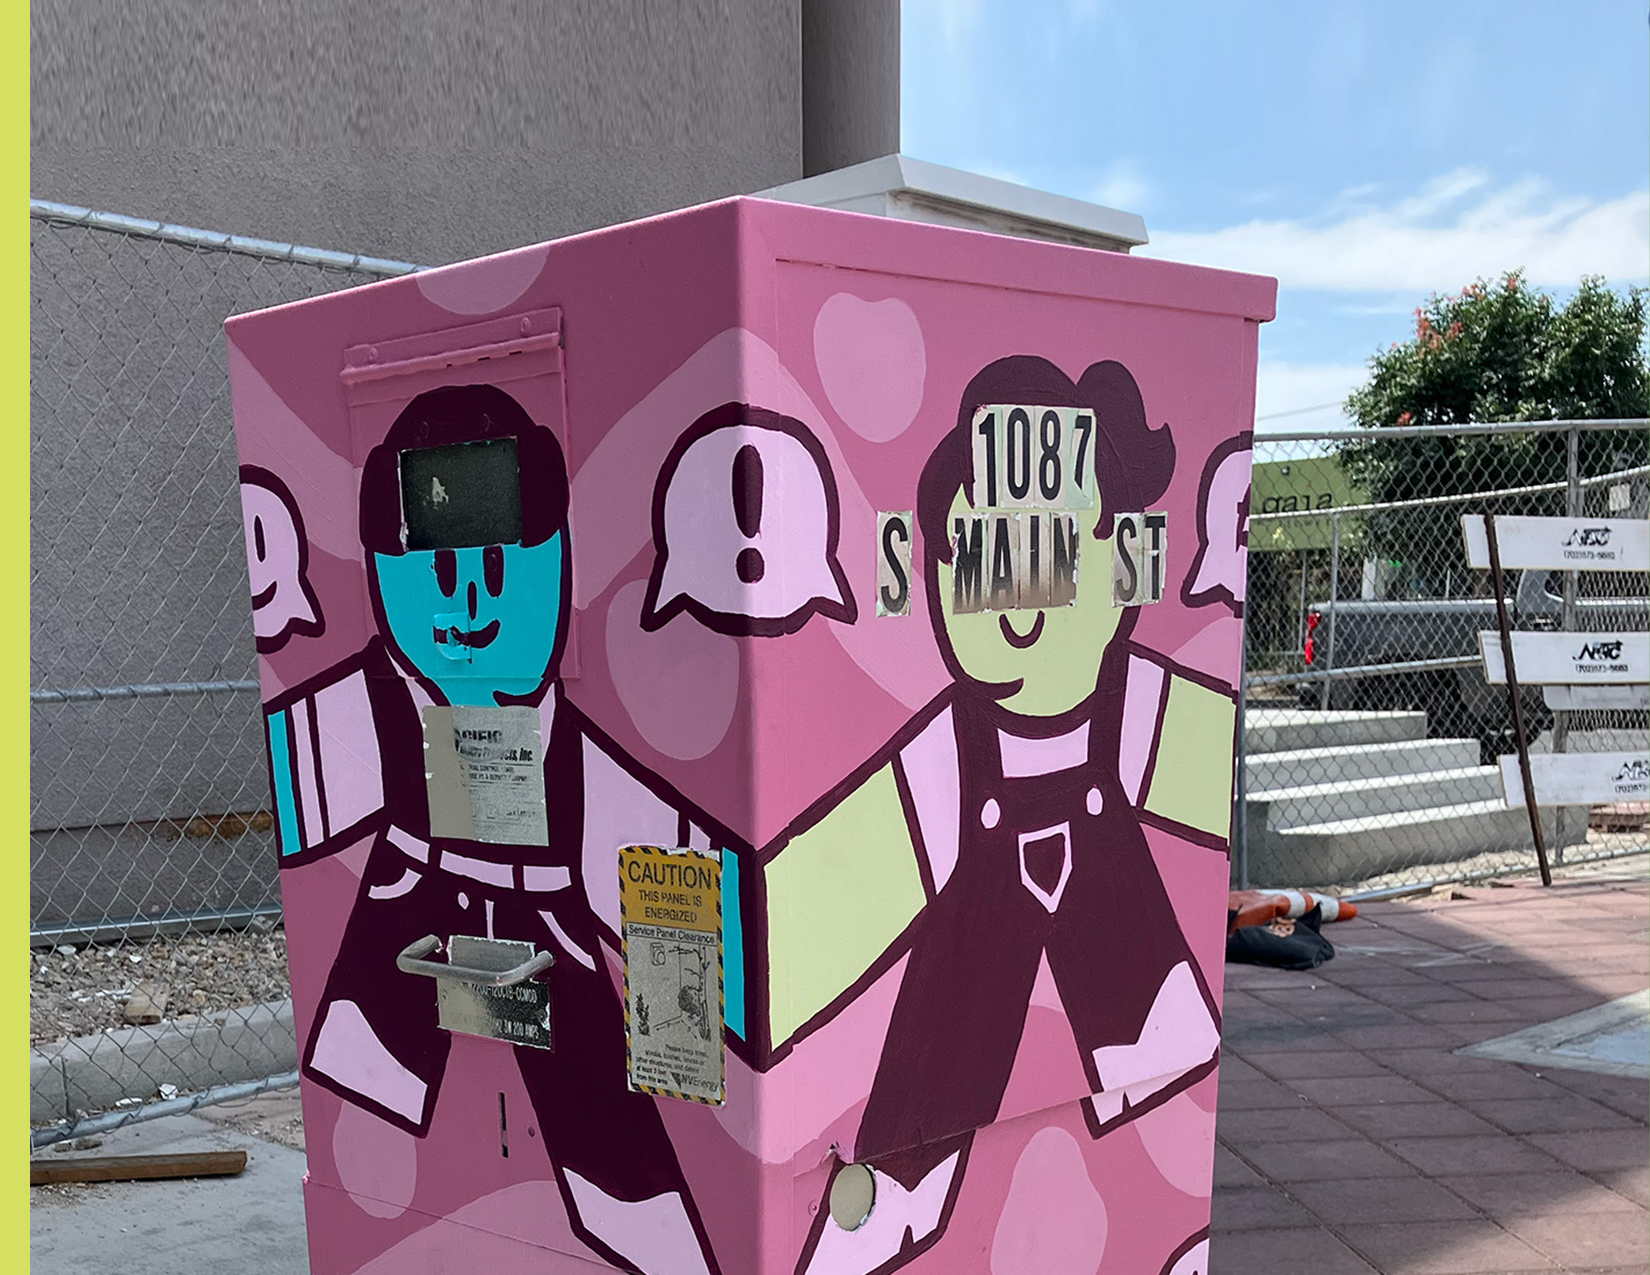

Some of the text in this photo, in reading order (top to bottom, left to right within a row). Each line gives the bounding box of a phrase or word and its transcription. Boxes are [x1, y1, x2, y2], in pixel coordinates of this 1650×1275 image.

[979, 407, 1092, 507] 1087
[880, 514, 1166, 613] S MAIN ST
[454, 727, 502, 743] ACIFIC
[628, 860, 712, 891] CAUTION
[638, 889, 702, 908] THIS PANEL IS
[644, 906, 698, 923] ENERGIZED
[628, 924, 715, 944] Service Panel Clearance
